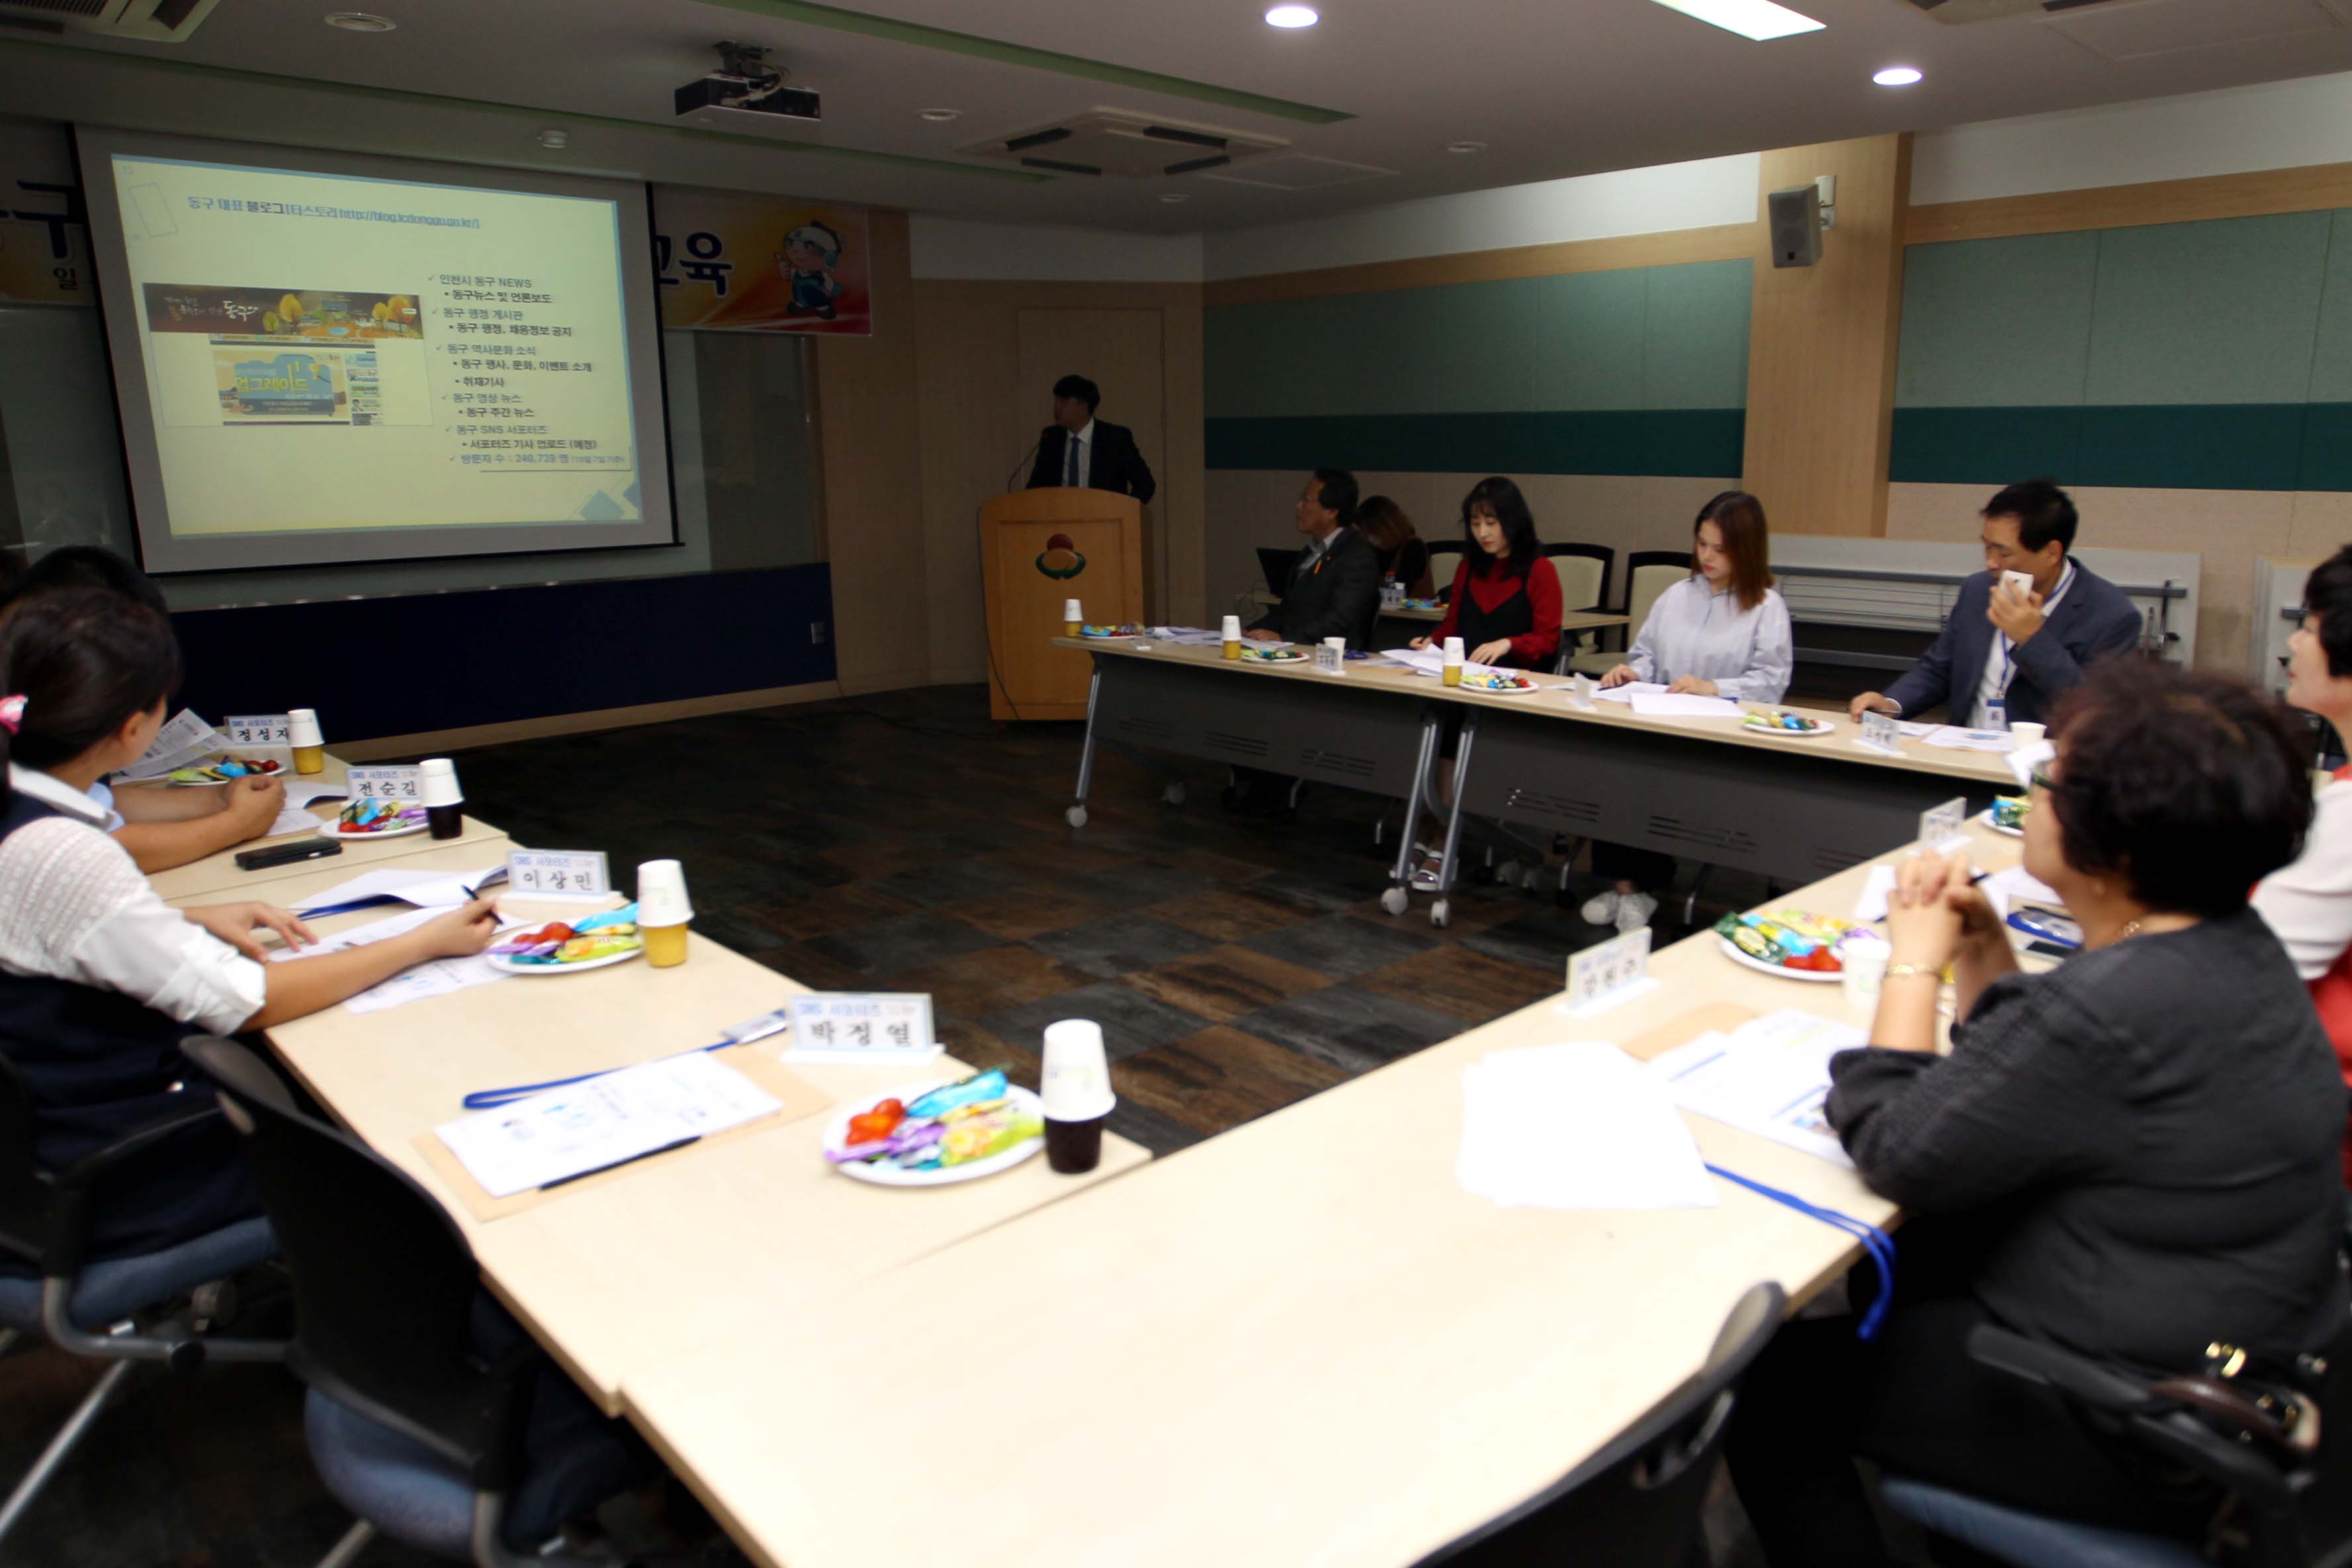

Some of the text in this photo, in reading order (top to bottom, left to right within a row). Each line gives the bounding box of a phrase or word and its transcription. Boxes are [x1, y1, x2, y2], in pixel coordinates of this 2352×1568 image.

[188, 197, 213, 210] 동구
[218, 198, 244, 211] 대표
[0, 179, 83, 258] 구
[53, 267, 79, 290] 일
[440, 274, 532, 288] 인천시 동구 NEWS
[453, 289, 552, 303] 동구뉴스 및 언론보도
[222, 301, 259, 322] 동구
[444, 307, 464, 318] 동구
[493, 309, 524, 321] 게시판
[457, 322, 477, 333] 동구
[509, 325, 550, 336] 채용정보
[552, 326, 572, 337] 공지
[448, 344, 536, 356] 동구 역사문화 소식
[462, 359, 481, 369] 동구
[539, 361, 569, 371] 이벤트
[572, 362, 592, 372] 소개
[236, 364, 309, 392] 업그레이드
[463, 377, 505, 387] 취재기사
[453, 393, 522, 403] 동구 영상 뉴스
[466, 407, 535, 418] 동구 주간 뉴스
[457, 424, 548, 435] 동구 SNS 서포터즈
[470, 440, 597, 450] 서포터즈 기사 업로드 (예정)
[358, 781, 416, 797] 전순길
[523, 869, 593, 891] 이상민
